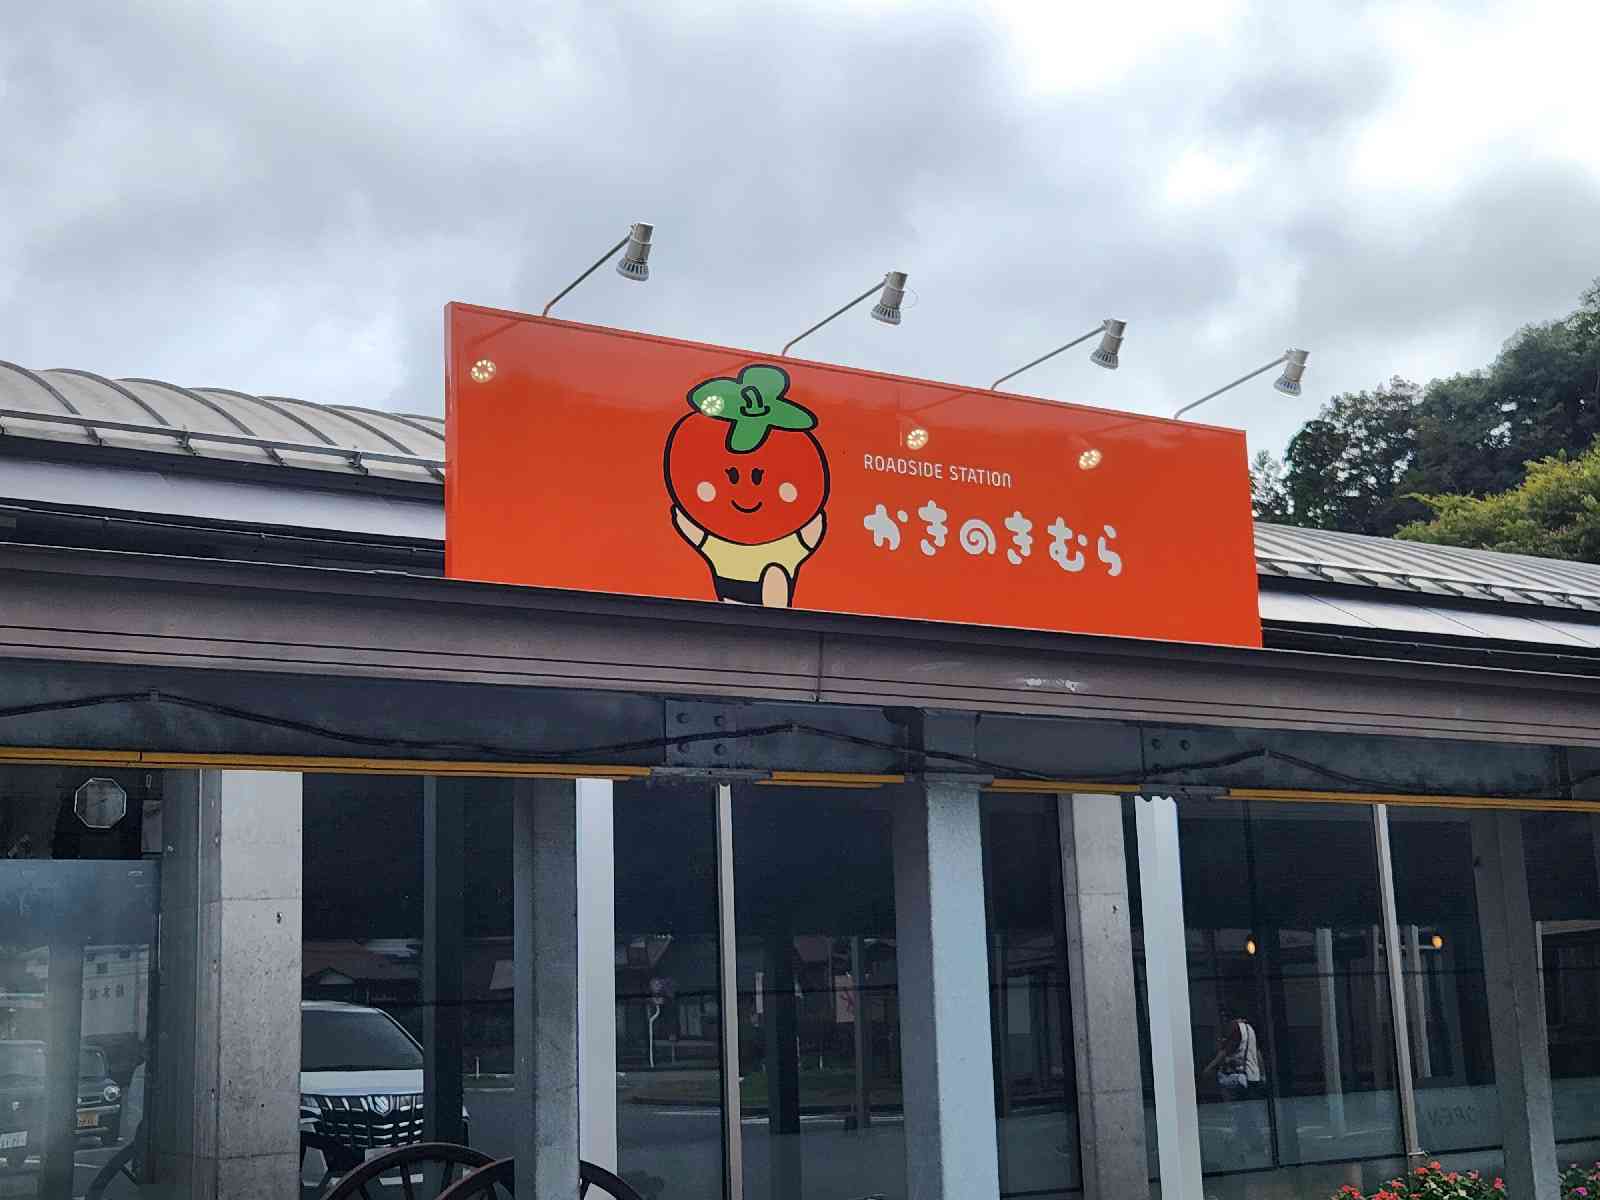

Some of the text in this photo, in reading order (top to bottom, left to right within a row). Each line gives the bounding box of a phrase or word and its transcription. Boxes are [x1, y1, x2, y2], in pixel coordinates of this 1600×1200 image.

[863, 454, 1012, 489] ROADSIDE STATION
[863, 499, 1123, 577] かきのきむら
